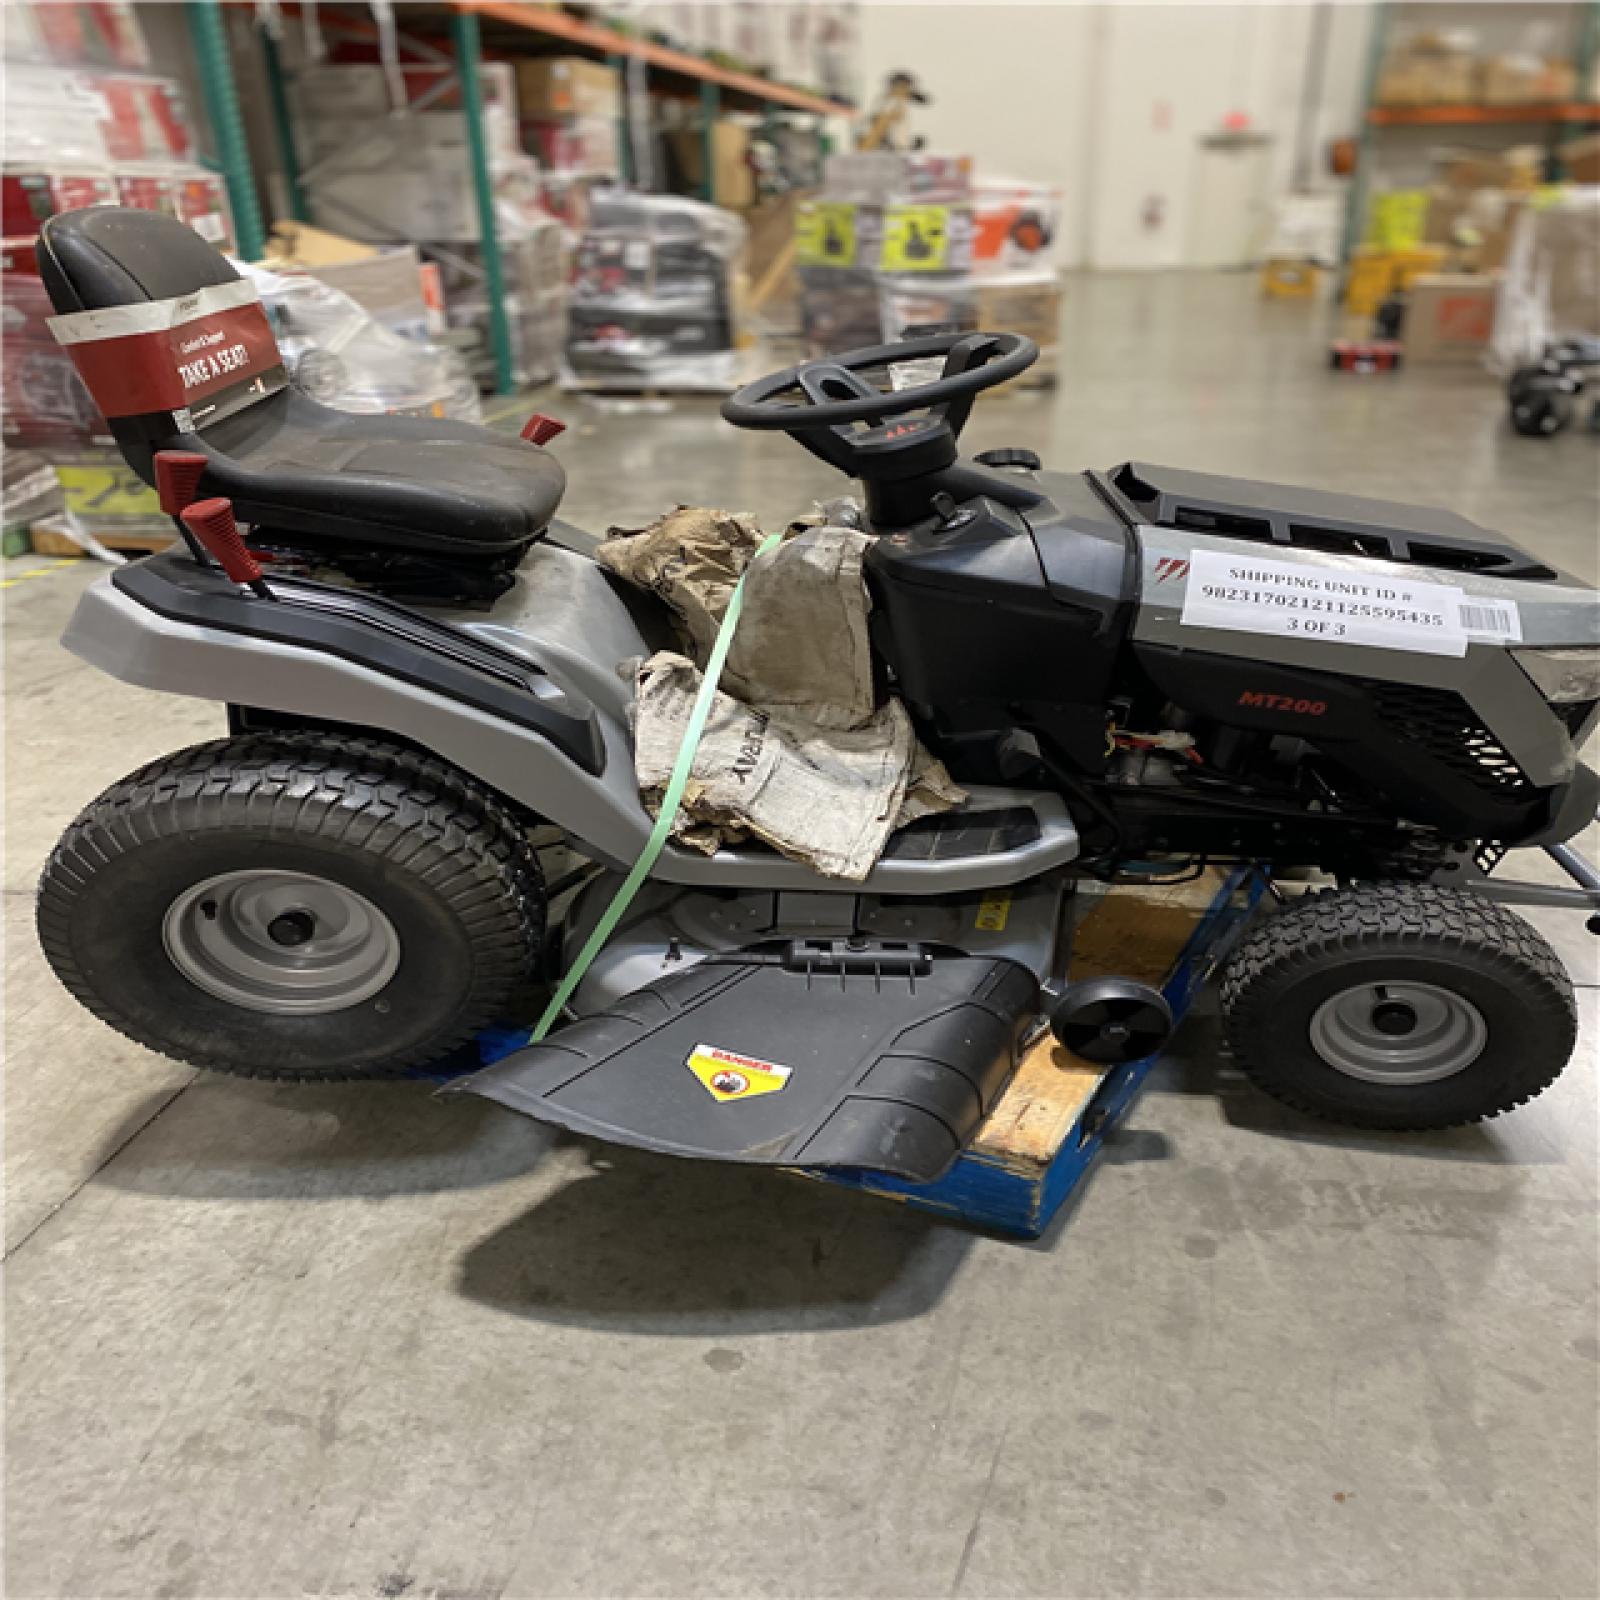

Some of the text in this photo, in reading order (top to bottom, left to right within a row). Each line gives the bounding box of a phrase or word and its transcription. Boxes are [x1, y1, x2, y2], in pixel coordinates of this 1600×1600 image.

[1229, 569, 1320, 590] SHIPPING
[1324, 580, 1369, 596] UNIT
[1376, 588, 1396, 601] ID
[1287, 616, 1346, 635] 3 OF 3
[1236, 691, 1327, 716] MT200
